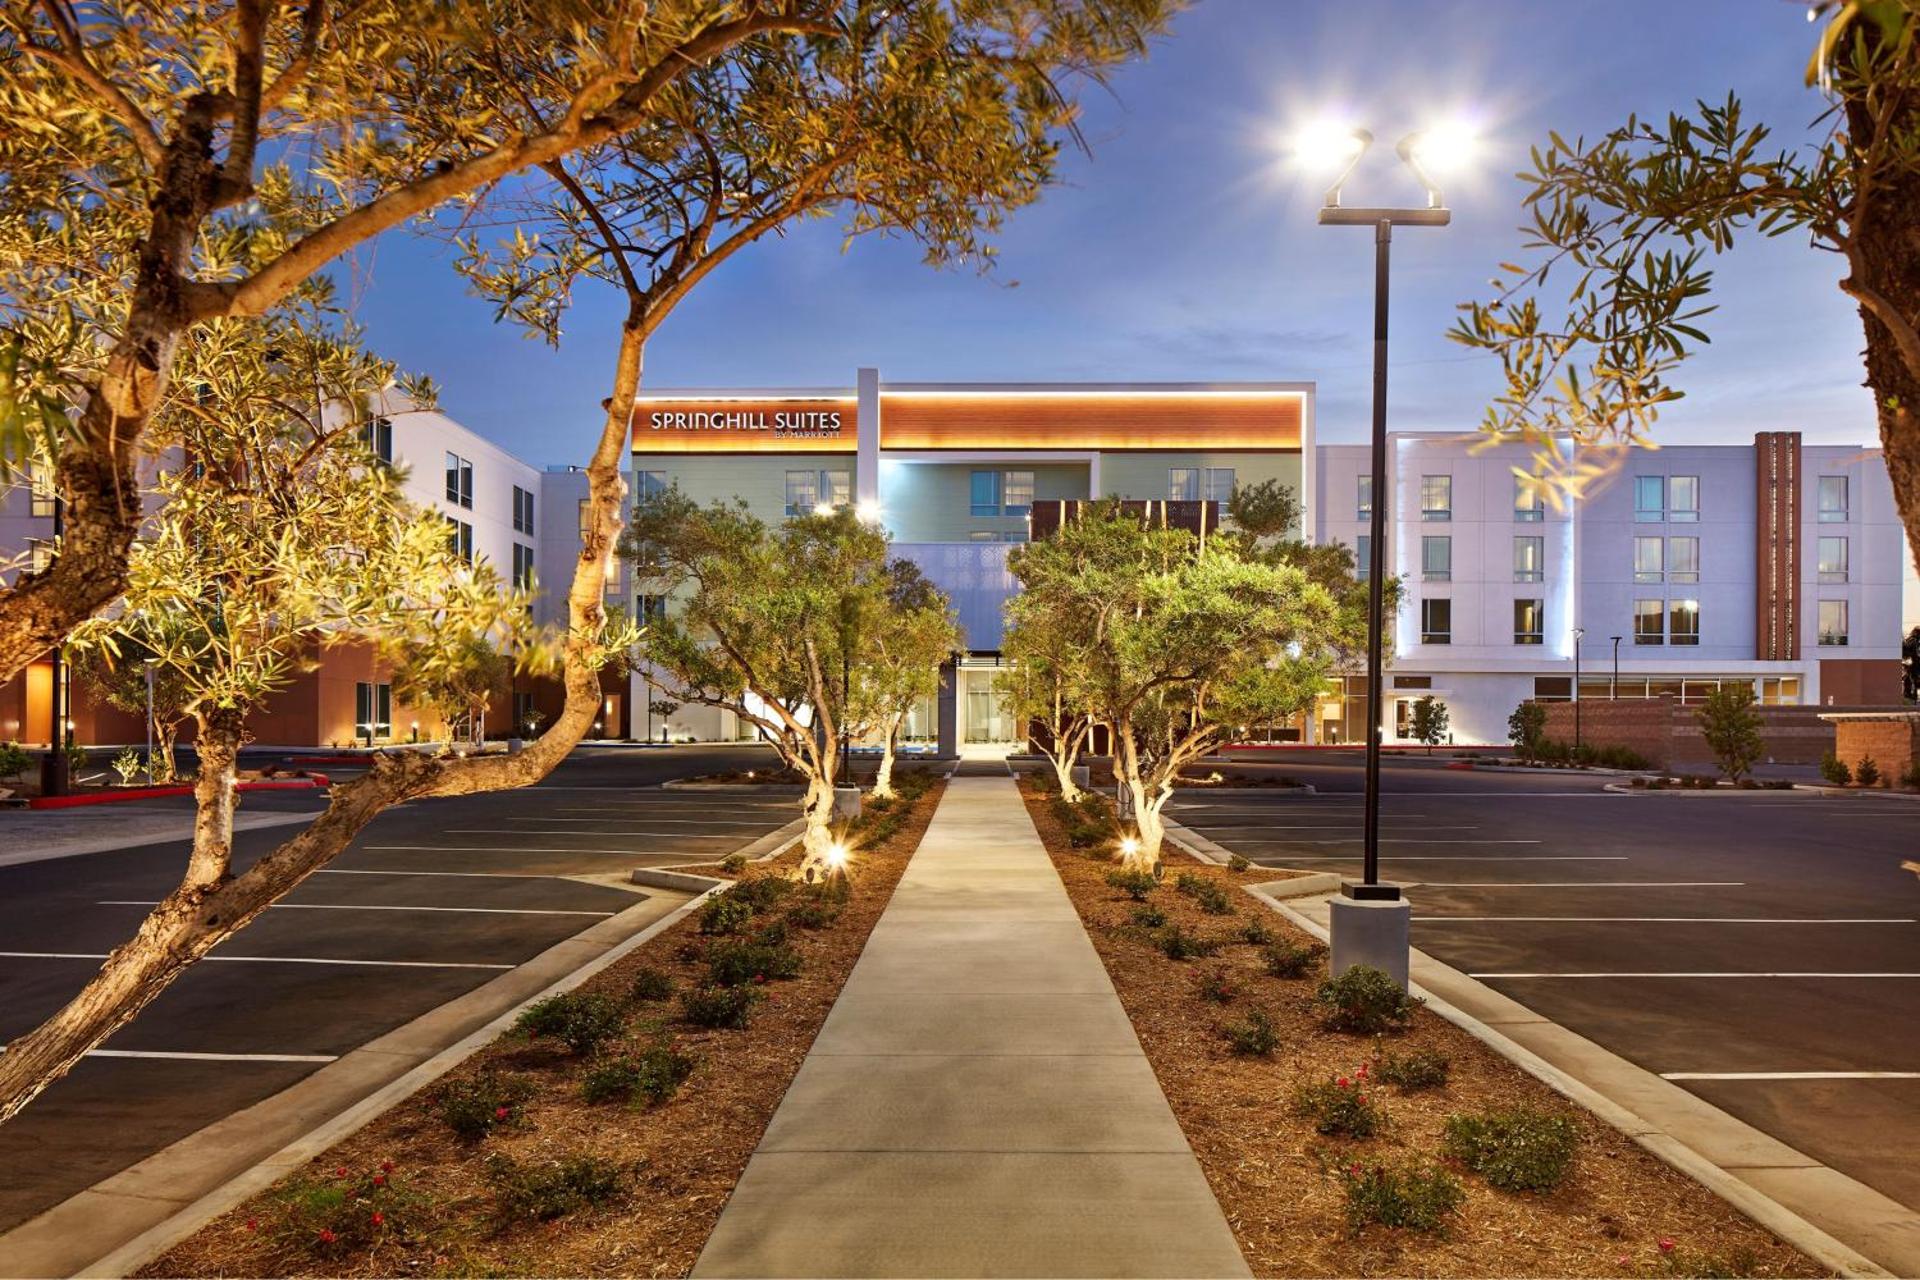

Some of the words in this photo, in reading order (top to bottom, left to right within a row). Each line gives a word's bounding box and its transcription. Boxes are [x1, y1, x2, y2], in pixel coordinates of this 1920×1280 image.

[651, 412, 769, 429] SPRINGHILL
[775, 412, 841, 429] SUITES
[775, 431, 786, 439] BY
[790, 431, 841, 439] MARRIOTT
